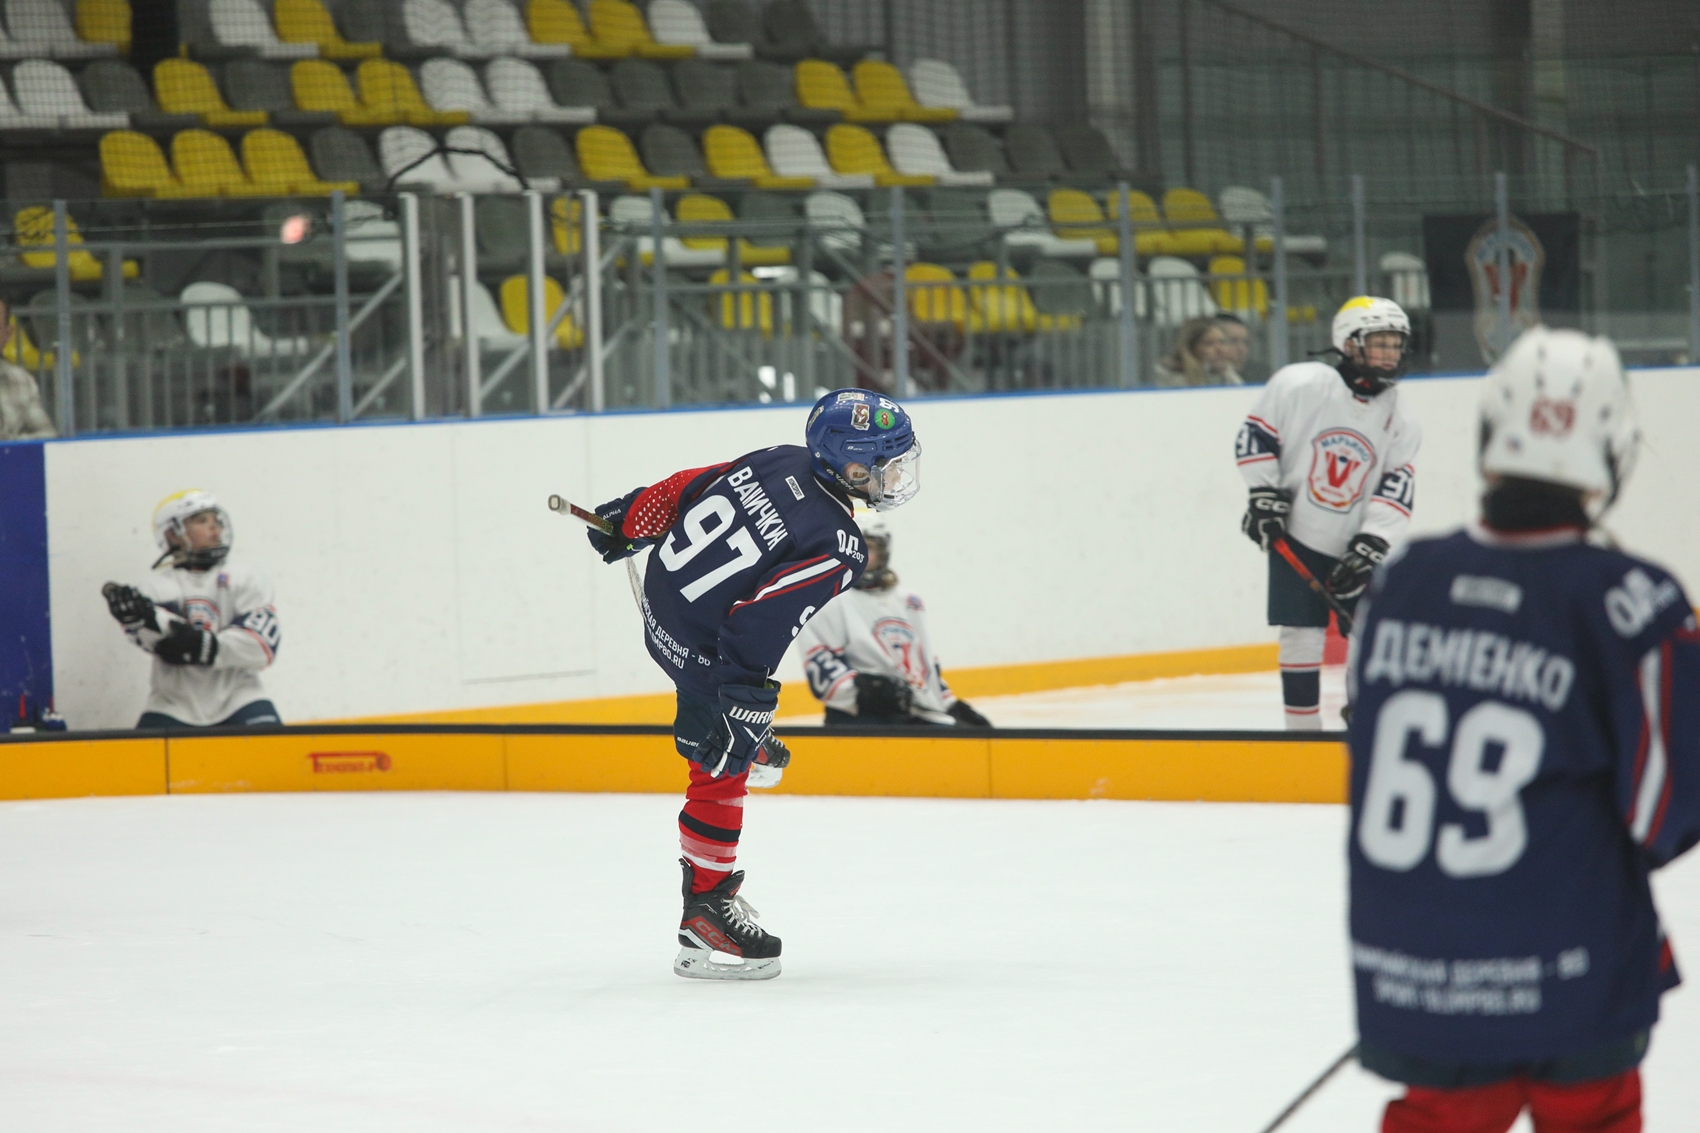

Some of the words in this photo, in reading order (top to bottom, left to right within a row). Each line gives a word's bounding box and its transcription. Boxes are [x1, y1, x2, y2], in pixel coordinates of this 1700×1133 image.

[1382, 470, 1413, 504] 31
[659, 495, 762, 602] 97
[655, 626, 689, 658] ДЕРЕВНЯ
[808, 651, 849, 693] 23
[1358, 689, 1546, 878] 69
[695, 920, 739, 953] CCM
